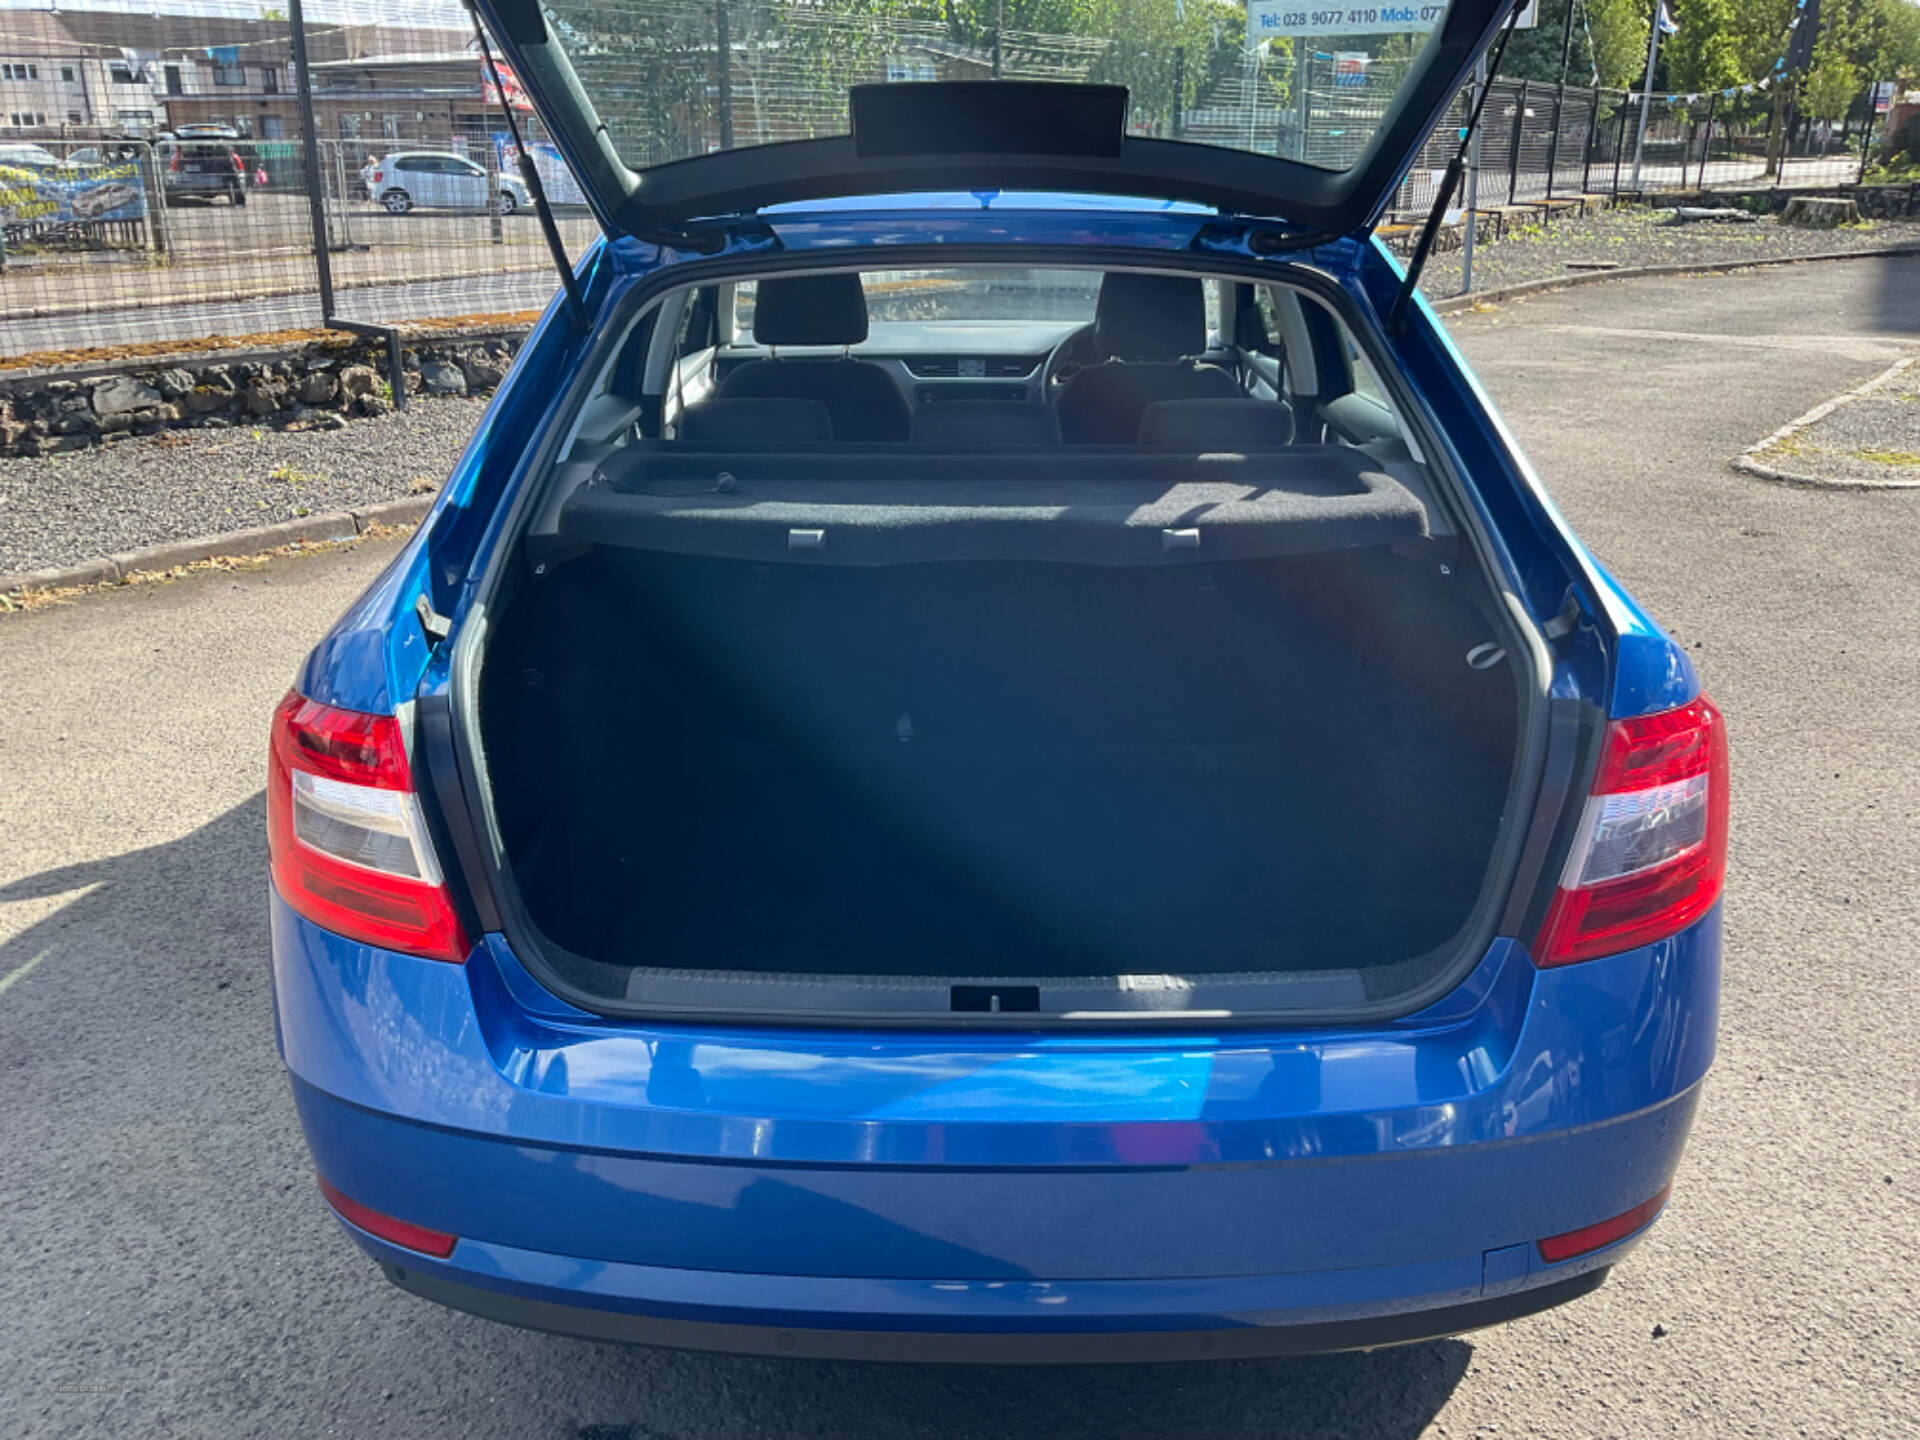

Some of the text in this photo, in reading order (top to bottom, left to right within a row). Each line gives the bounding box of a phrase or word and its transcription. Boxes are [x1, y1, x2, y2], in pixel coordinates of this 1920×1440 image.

[1259, 13, 1280, 28] Tel:
[1283, 12, 1307, 26] 028
[1311, 10, 1343, 25] 9077
[1347, 8, 1377, 23] 4110
[1380, 7, 1418, 22] Mob:
